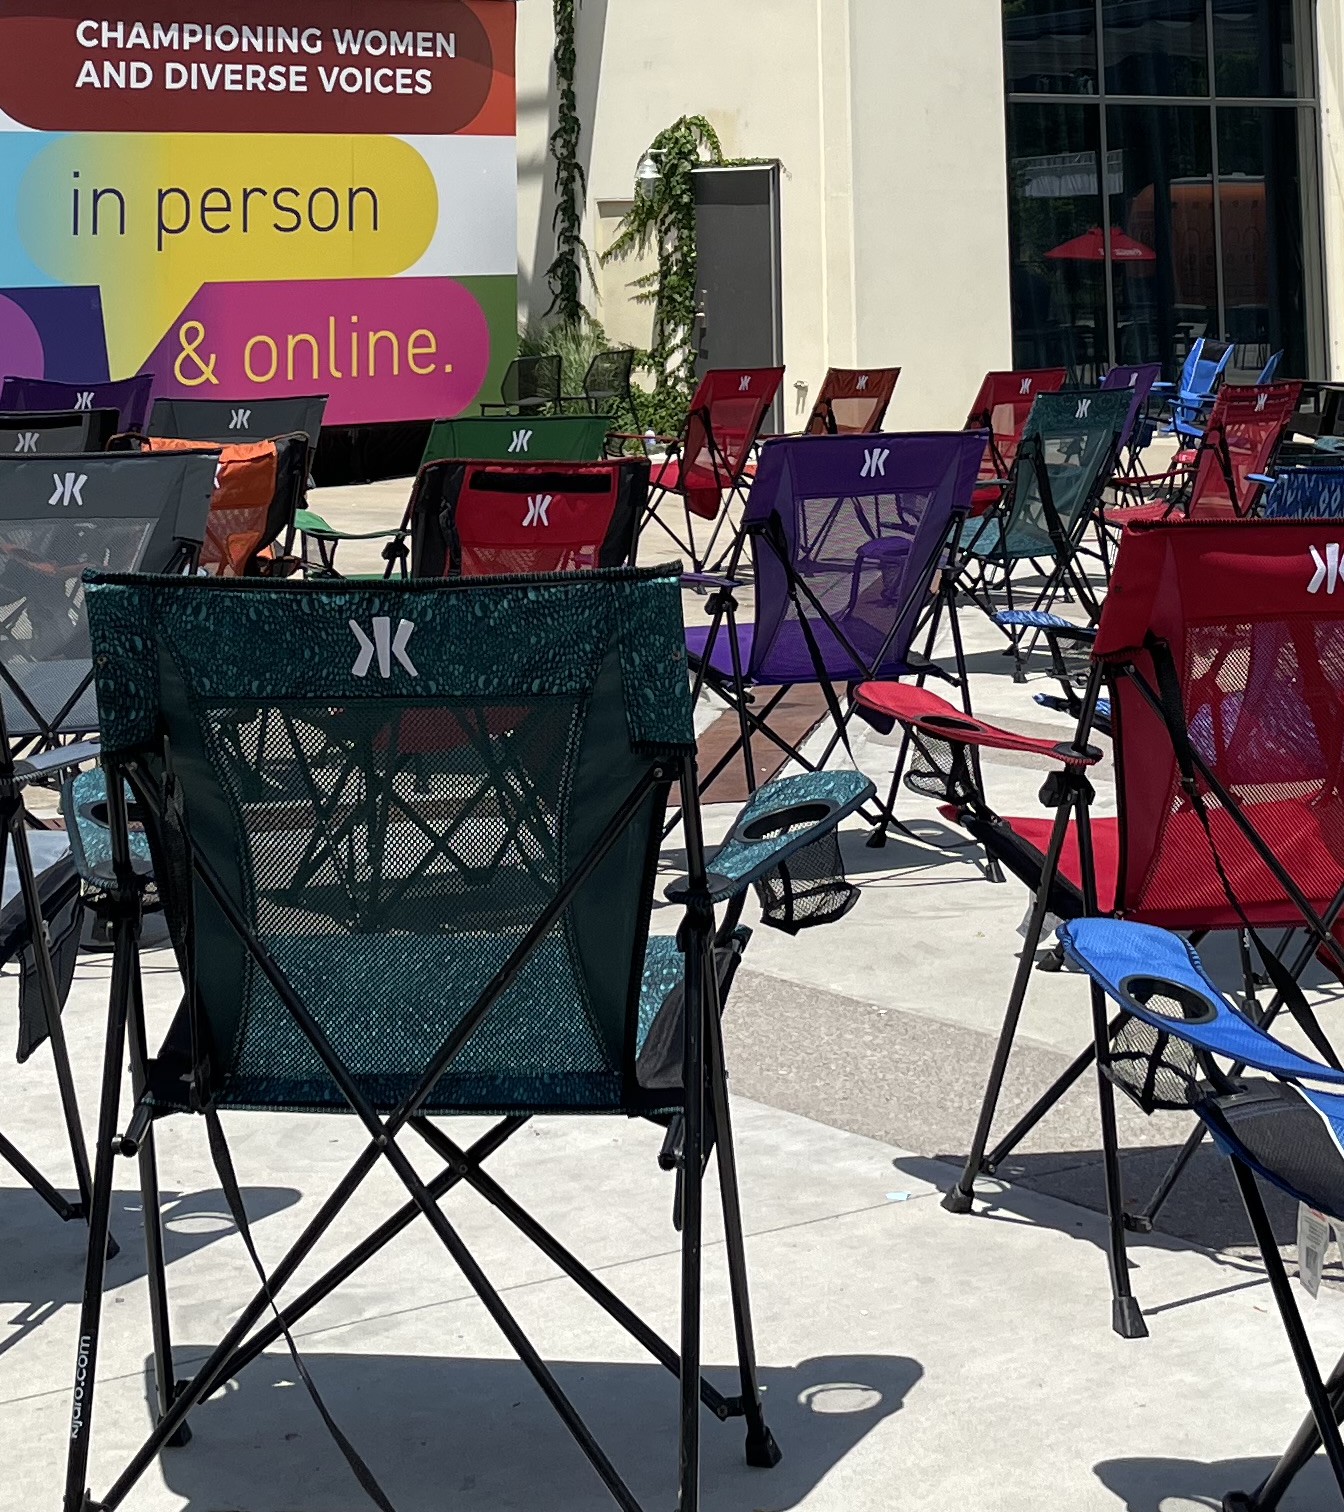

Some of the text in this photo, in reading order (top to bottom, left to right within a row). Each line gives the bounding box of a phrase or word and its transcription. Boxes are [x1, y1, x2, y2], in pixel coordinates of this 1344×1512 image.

[75, 20, 457, 59] CHAMPIONING WOMEN
[75, 60, 433, 95] AND DIVERSE VOICES
[72, 171, 379, 252] in person
[173, 315, 453, 387] & online.
